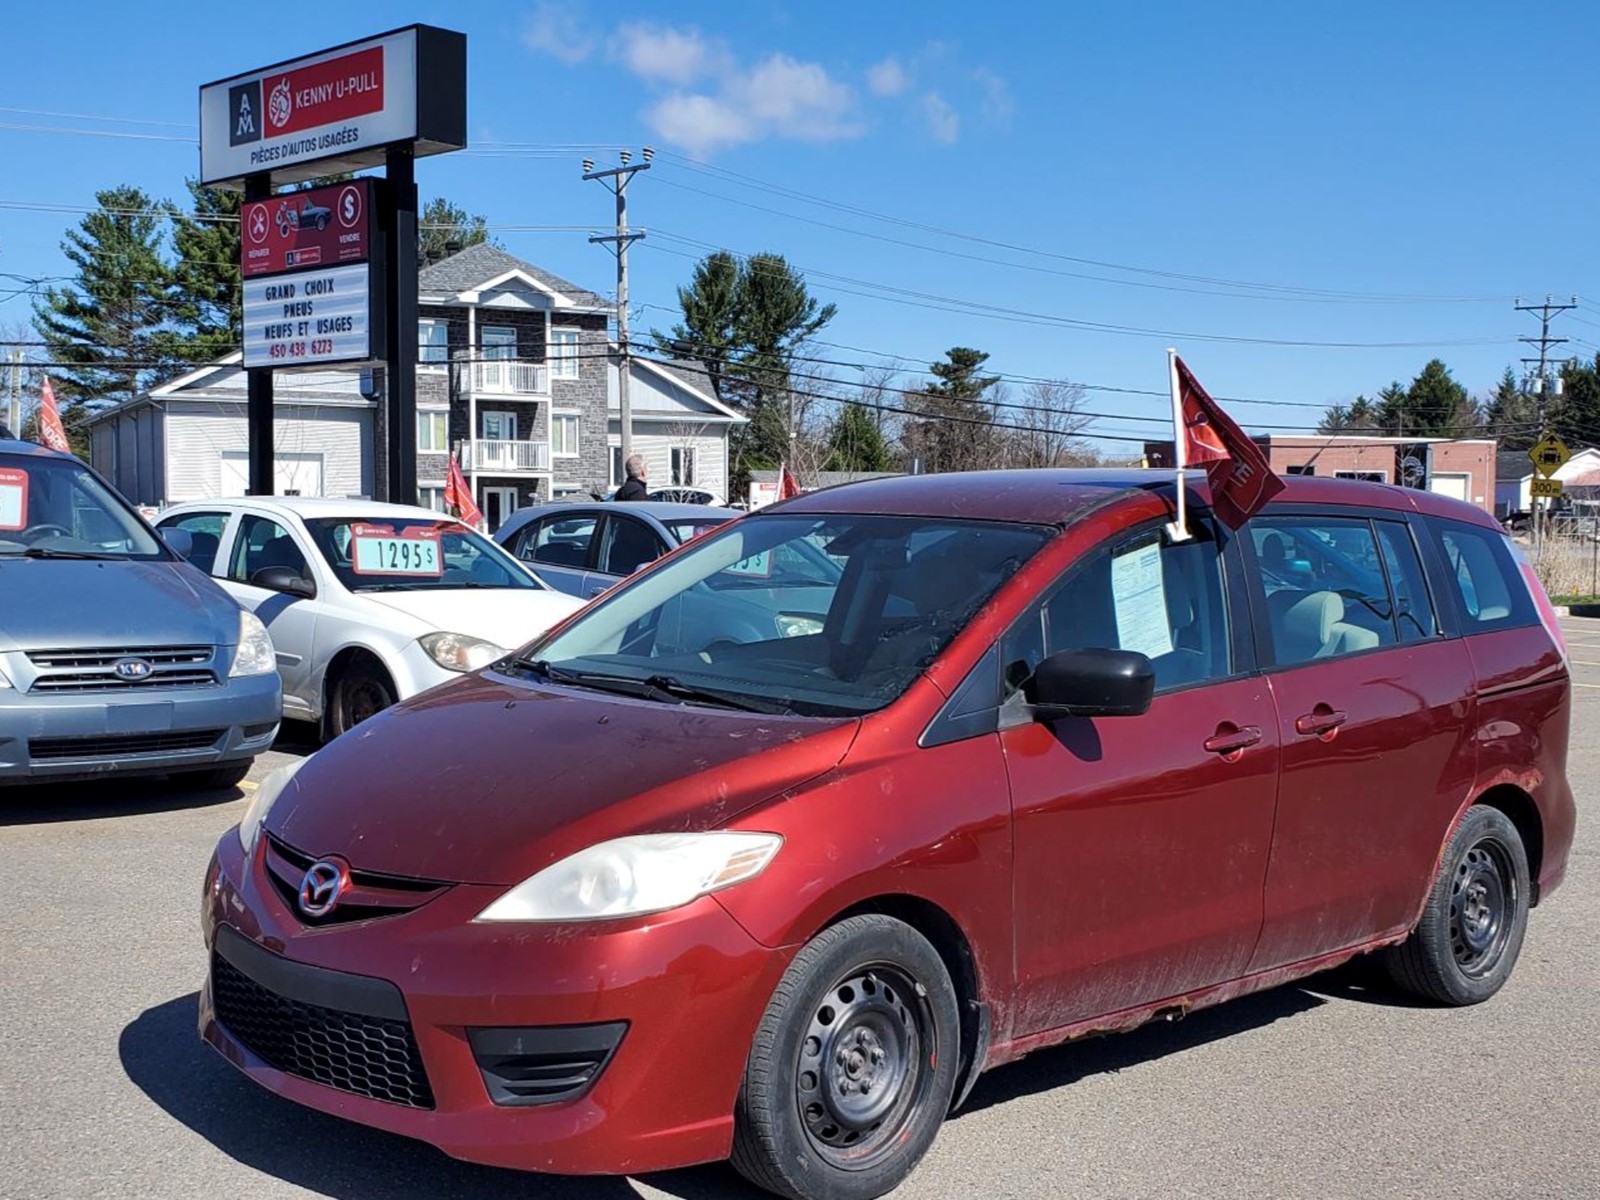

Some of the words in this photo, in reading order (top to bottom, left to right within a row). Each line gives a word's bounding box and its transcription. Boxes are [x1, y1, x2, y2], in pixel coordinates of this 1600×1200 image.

[296, 81, 335, 109] KENNY
[336, 72, 378, 98] U-PULL
[251, 143, 280, 165] PIÈCES
[281, 139, 317, 160] D'AUTOS
[318, 127, 359, 150] USAGÉES
[265, 284, 296, 301] GRAND
[304, 278, 335, 295] CHOIX
[283, 301, 313, 318] PNEUS
[265, 323, 293, 340] NEUFS
[298, 321, 310, 336] ET
[317, 317, 353, 333] USAGES
[269, 343, 286, 358] 450
[289, 342, 306, 357] 438
[311, 339, 333, 354] 6273
[1532, 482, 1551, 493] 300
[120, 663, 148, 675] KIA
